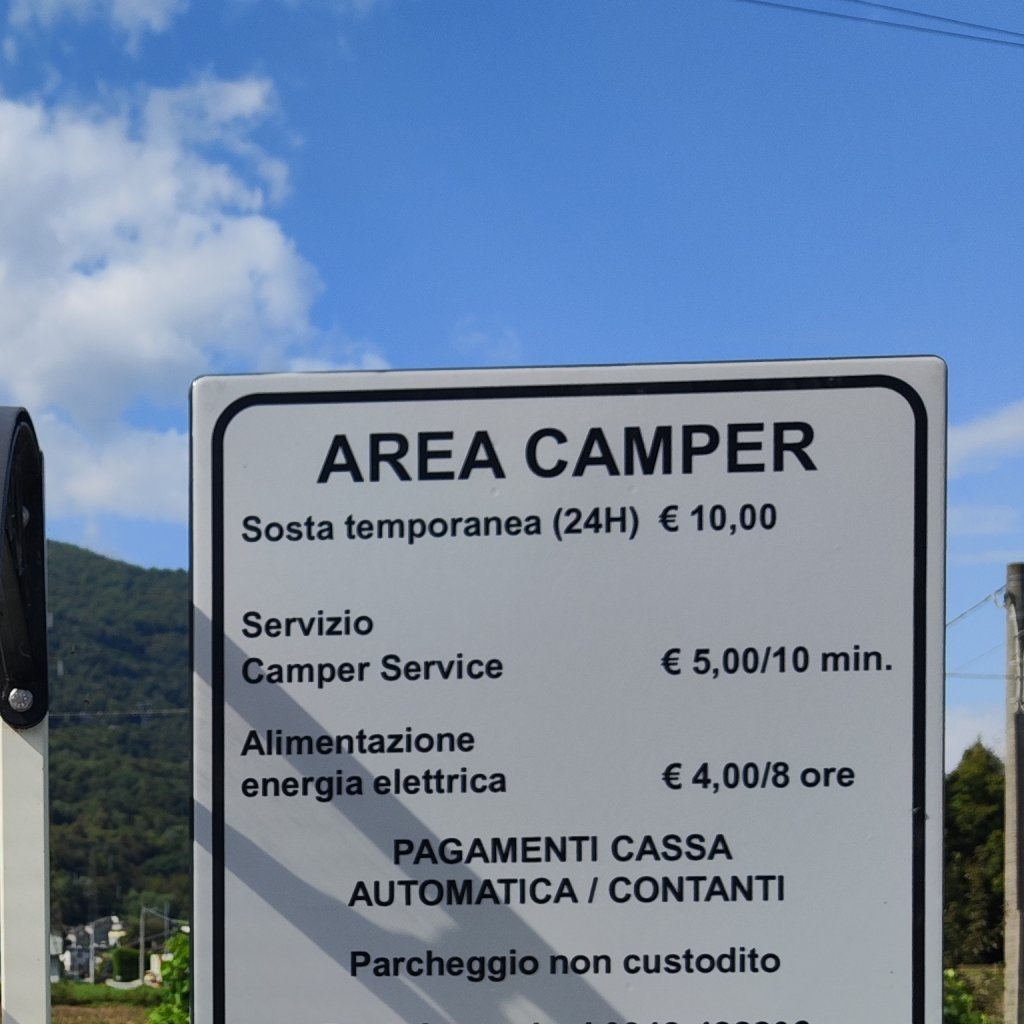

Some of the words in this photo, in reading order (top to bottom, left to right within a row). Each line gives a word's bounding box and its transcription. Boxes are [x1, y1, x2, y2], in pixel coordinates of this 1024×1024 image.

[317, 430, 507, 484] AREA
[525, 421, 819, 479] CAMPER
[242, 515, 336, 543] Sosta
[344, 512, 543, 547] temporanea
[552, 505, 641, 542] (24H)
[659, 505, 681, 533] €
[689, 502, 778, 536] 10,00
[242, 609, 375, 639] Servizio
[242, 657, 372, 692] Camper
[381, 653, 505, 682] Service
[661, 648, 683, 676] €
[693, 645, 811, 680] 5,00/10
[821, 645, 894, 673] min.
[241, 727, 476, 758] Alimentazione
[242, 769, 365, 803] energia
[374, 766, 508, 796] elettrica
[662, 762, 684, 791] €
[692, 760, 792, 794] 4,00/8
[800, 766, 857, 788] ore
[394, 835, 599, 866] PAGAMENTI
[611, 833, 735, 863] CASSA
[348, 877, 580, 909] AUTOMATICA
[588, 876, 600, 905] /
[609, 874, 786, 904] CONTANTI
[351, 948, 541, 983] Parcheggio
[550, 954, 613, 976] non
[623, 946, 782, 975] custodito
